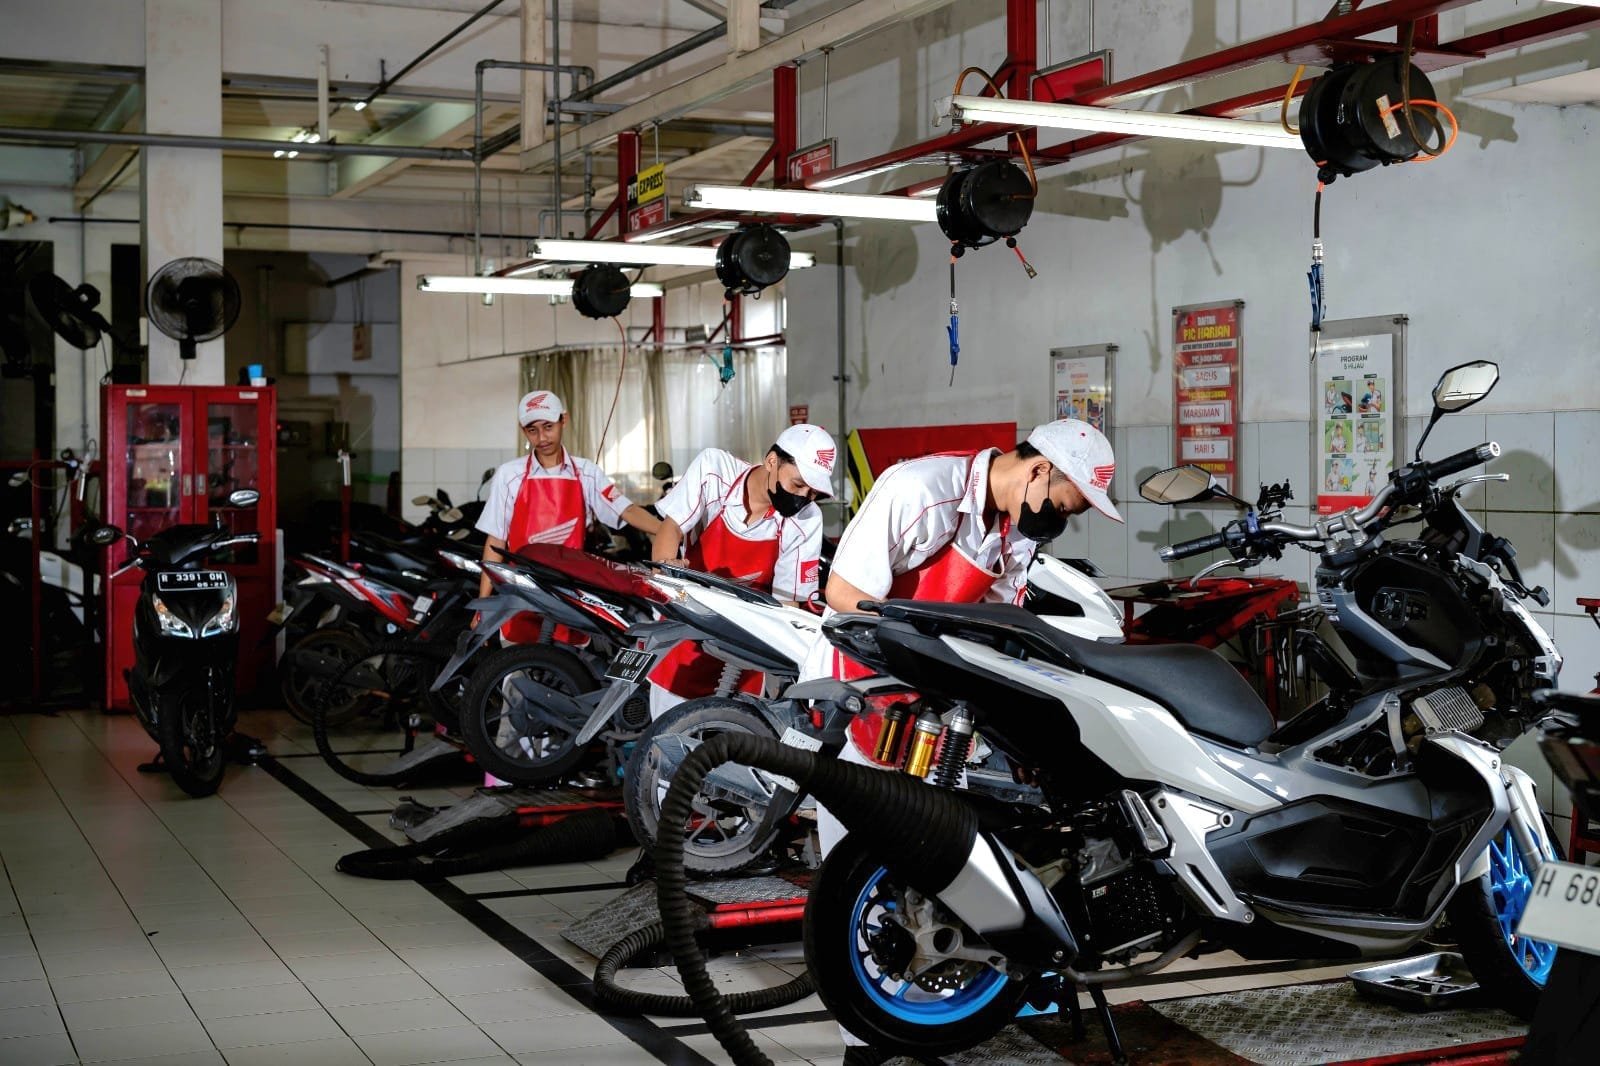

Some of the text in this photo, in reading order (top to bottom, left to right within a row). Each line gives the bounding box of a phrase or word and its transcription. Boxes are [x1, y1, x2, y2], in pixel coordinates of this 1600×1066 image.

[791, 160, 802, 181] 16
[639, 171, 664, 195] EXPRESS
[630, 213, 641, 231] 15
[1197, 325, 1231, 340] HARIAN
[1340, 355, 1368, 363] PROGRAM
[1183, 408, 1220, 418] MARSIMAN
[1194, 444, 1209, 453] HARI
[1536, 867, 1557, 897] H
